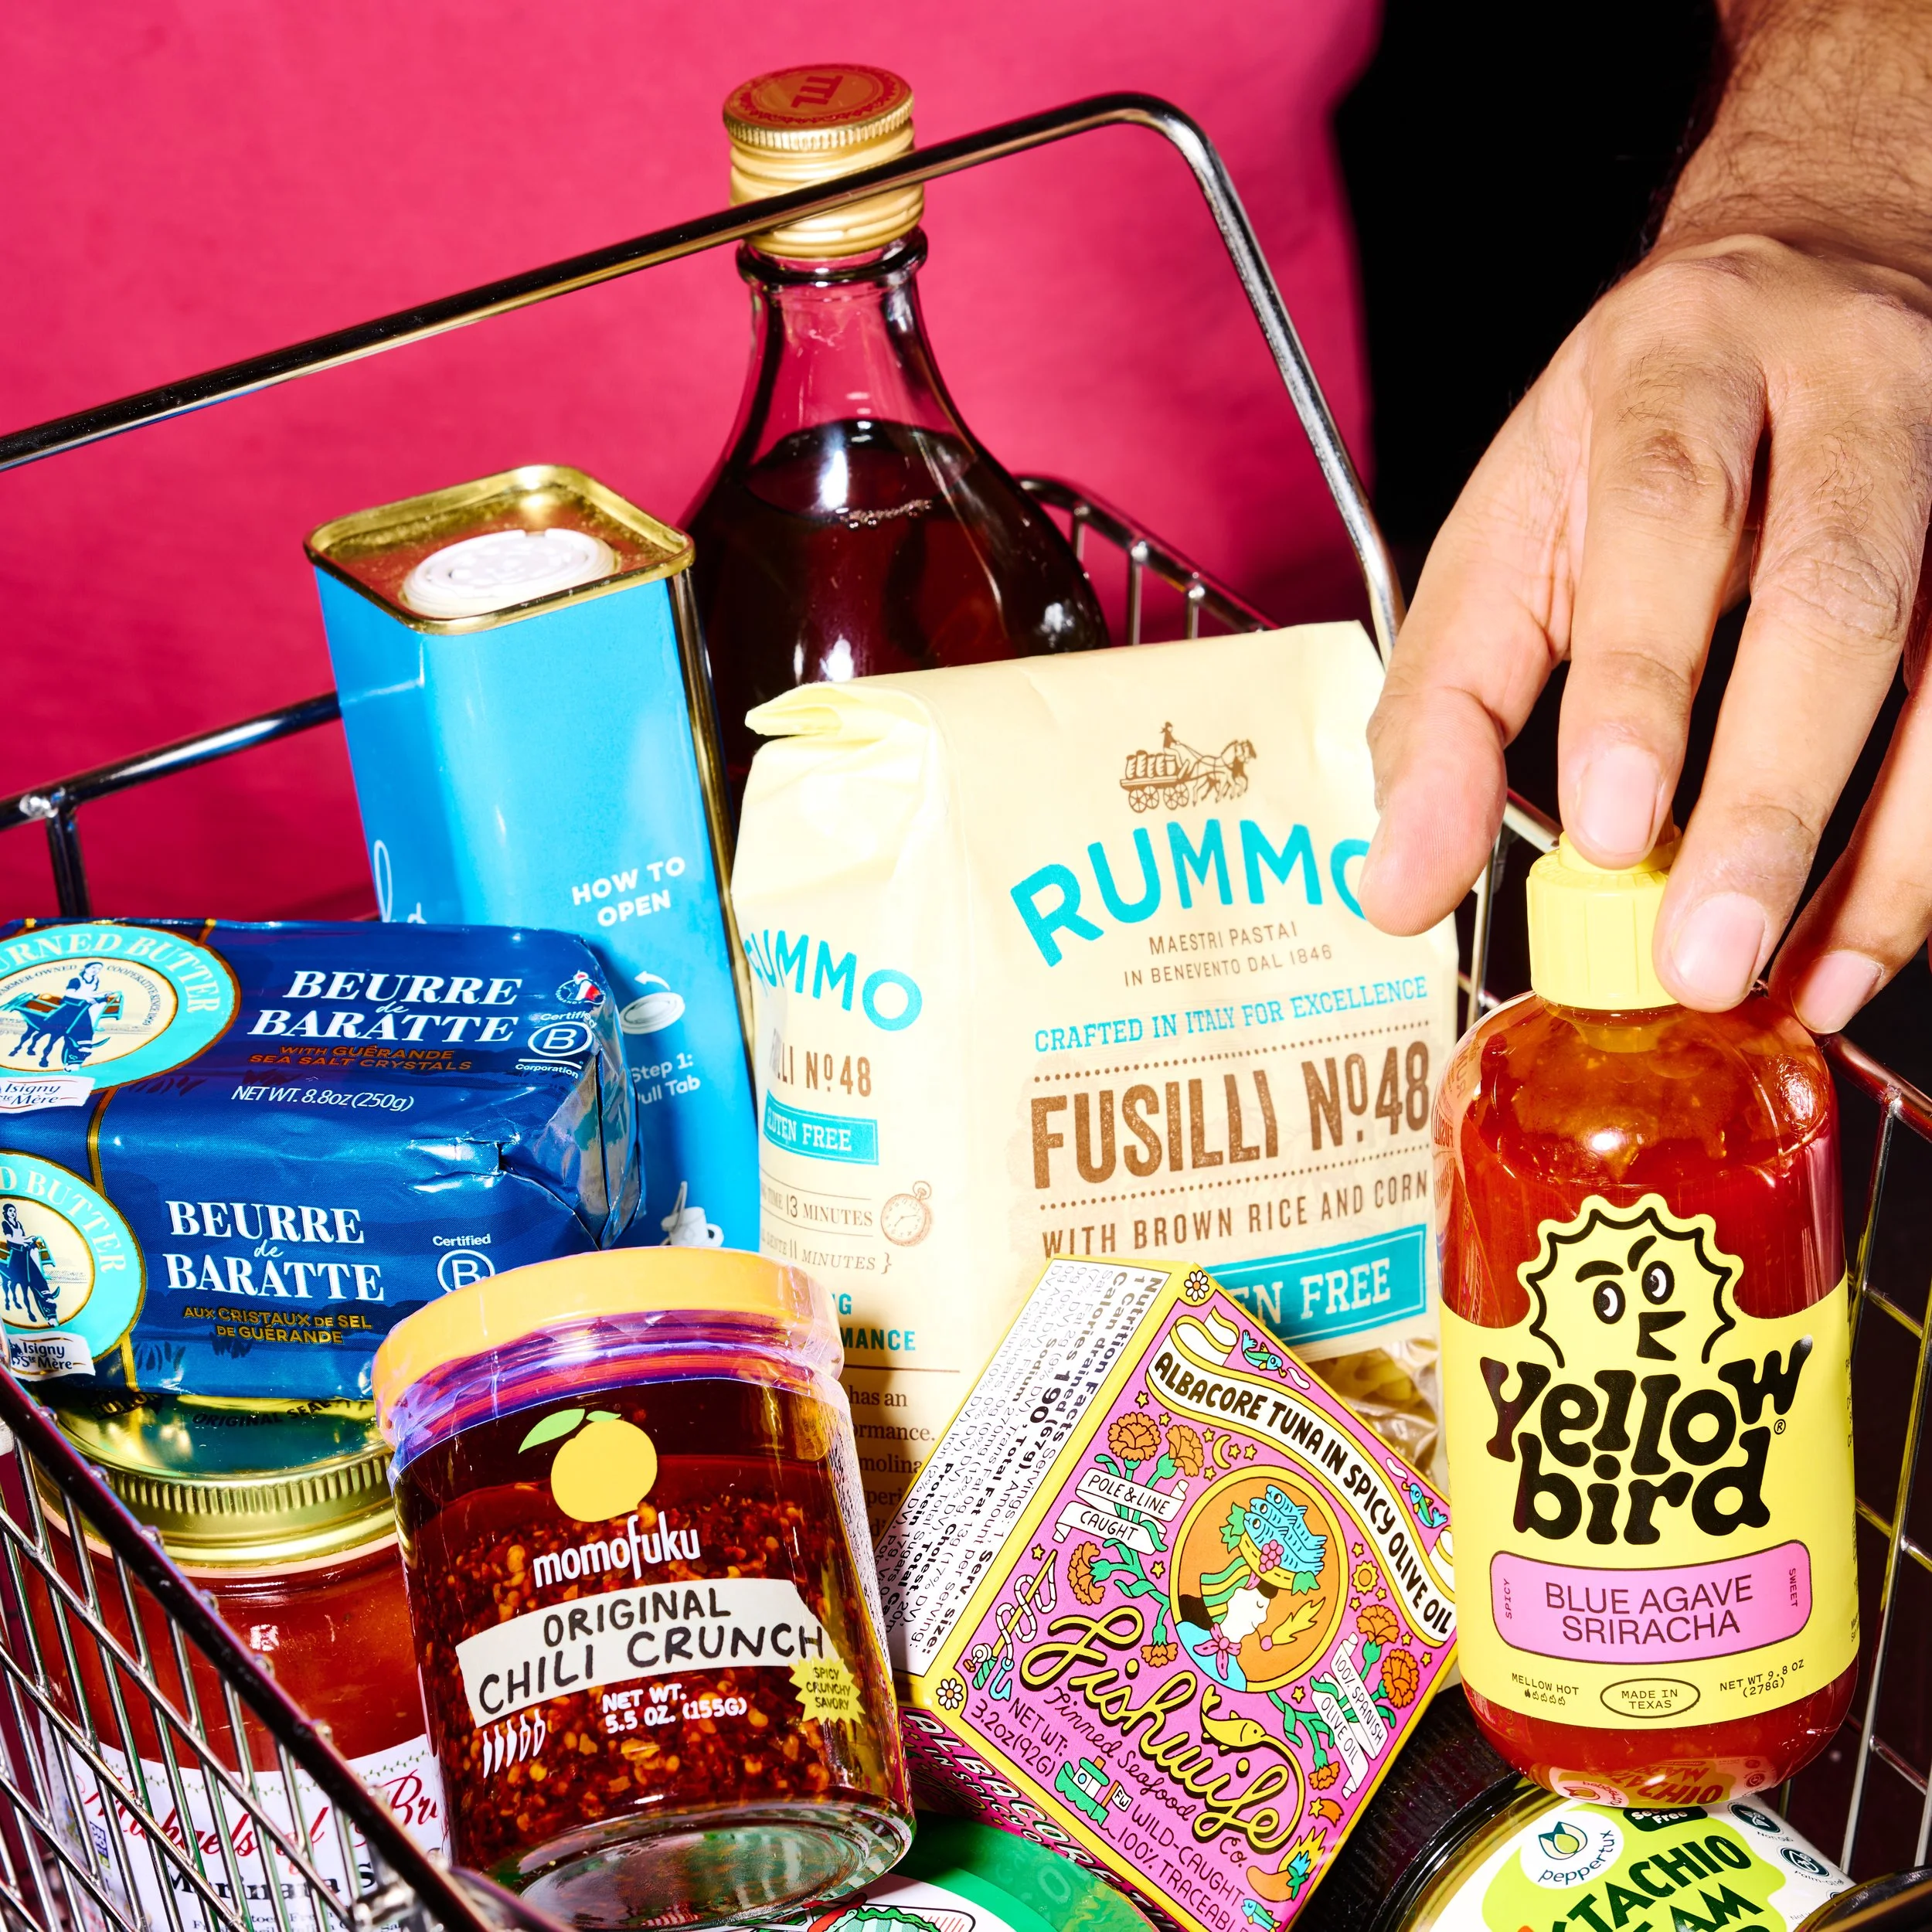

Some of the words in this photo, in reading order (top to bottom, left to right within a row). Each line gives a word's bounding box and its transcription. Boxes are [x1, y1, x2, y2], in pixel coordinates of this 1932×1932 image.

[570, 869, 639, 906] HOW
[647, 855, 686, 883] TO
[597, 889, 672, 927] OPEN
[1149, 930, 1225, 956] MAESTRI
[1230, 921, 1298, 946] PASTAI
[124, 936, 221, 1014] BUTTER
[1124, 970, 1143, 987] IN
[1150, 959, 1240, 984] BENEVENTO
[1247, 952, 1283, 972] DAL
[1291, 944, 1333, 966] 1846
[282, 971, 522, 1005] BEURRE
[376, 1001, 410, 1014] de
[247, 1009, 519, 1043] BARATTE
[540, 1011, 597, 1029] Certified
[1034, 1018, 1143, 1053] CRAFTED
[1153, 1012, 1178, 1037] IN
[1185, 1006, 1236, 1035] ITALY
[1243, 999, 1286, 1026] FOR
[1290, 976, 1428, 1018] EXCELLENCE
[249, 1055, 291, 1064] SEA
[298, 1056, 354, 1066] SALT
[359, 1059, 472, 1070] CRYSTALS
[280, 1046, 327, 1056] WITH
[332, 1045, 454, 1060] GUÉRANDE
[515, 1063, 579, 1079] Corporation
[631, 1060, 672, 1083] Step
[676, 1052, 693, 1070] 1:
[5, 1083, 61, 1095] Isigny
[231, 1086, 270, 1101] NET
[270, 1087, 301, 1103] WT.
[665, 1074, 701, 1097] Tab
[801, 1123, 852, 1151] FREE
[1030, 1070, 1279, 1189] FUSILLI
[25, 1171, 126, 1273] BUTTER
[165, 1200, 365, 1244] BEURRE
[787, 1194, 798, 1218] 13
[803, 1203, 873, 1227] MINUTES
[1043, 1223, 1117, 1260] WITH
[1134, 1208, 1233, 1250] BROWN
[1248, 1196, 1308, 1233] RICE
[1321, 1185, 1363, 1221] AND
[1375, 1171, 1428, 1209] CORN
[253, 1239, 284, 1258] de
[433, 1233, 491, 1247] Certified
[801, 1249, 876, 1270] MINUTES
[162, 1253, 385, 1301] BARATTE
[1300, 1257, 1391, 1320] FREE
[183, 1307, 216, 1319] AUX
[218, 1308, 311, 1327] CRISTAUX
[315, 1316, 334, 1327] DE
[337, 1315, 372, 1329] SEL
[998, 1298, 1040, 1361] Calcium
[1065, 1268, 1128, 1365] Calories
[1093, 1273, 1163, 1378] Nutrition
[1104, 1289, 1136, 1333] Can
[22, 1342, 65, 1359] Isigny
[216, 1325, 236, 1337] DE
[239, 1325, 345, 1345] GUÉRANDE
[38, 1358, 73, 1370] Mère
[1011, 1335, 1058, 1405] Sodium
[1054, 1335, 1107, 1415] drained
[849, 1386, 879, 1406] has
[884, 1392, 907, 1407] an
[1051, 1377, 1098, 1446] Facts
[1480, 1335, 1813, 1476] Yellow
[191, 1411, 284, 1428] ORIGINAL
[935, 1430, 959, 1461] Iron
[987, 1420, 1019, 1466] Trans
[991, 1431, 1027, 1483] Total
[907, 1459, 954, 1529] Protein
[970, 1466, 991, 1493] Fat
[1088, 1475, 1125, 1498] POLE
[1137, 1492, 1170, 1515] LINE
[1154, 1352, 1267, 1420] ALBACORE
[1266, 1401, 1324, 1456] TUNA
[1322, 1439, 1348, 1475] IN
[1343, 1464, 1396, 1535] SPICY
[1389, 1531, 1428, 1609] OLIVE
[1423, 1599, 1453, 1634] OIL
[1513, 1427, 1770, 1544] bird
[921, 1490, 948, 1528] Total
[970, 1484, 995, 1518] Fat
[972, 1478, 1019, 1548] Amount
[948, 1519, 972, 1549] 13g
[1080, 1511, 1138, 1540] CAUGHT
[533, 1511, 700, 1588] momofuku
[885, 1527, 925, 1585] Sugars
[897, 1537, 932, 1588] Total
[905, 1520, 957, 1600] Cholest.
[952, 1546, 977, 1578] per
[953, 1546, 993, 1604] Serv.
[1545, 1581, 1630, 1614] BLUE
[1638, 1574, 1753, 1615] AGAVE
[1788, 1568, 1798, 1607] SWEET
[543, 1588, 731, 1647] ORIGINAL
[1504, 1578, 1512, 1619] SPICY
[920, 1605, 957, 1657] size:
[1562, 1611, 1740, 1645] SRIRACHA
[479, 1645, 593, 1715] CHILI
[627, 1624, 824, 1668] CRUNCH
[812, 1666, 840, 1679] SPICY
[1512, 1672, 1553, 1692] MELLOW
[1556, 1685, 1580, 1696] HOT
[1719, 1679, 1744, 1692] NET
[1747, 1674, 1763, 1685] WT
[1767, 1665, 1789, 1680] 9.8
[1791, 1659, 1804, 1670] OZ
[1743, 1677, 1785, 1699] (278G)
[602, 1689, 644, 1713] NET
[648, 1683, 688, 1704] WT.
[806, 1682, 851, 1697] CRUNCHY
[815, 1696, 850, 1710] SAVORY
[1335, 1655, 1355, 1688] 100%
[1352, 1686, 1384, 1746] SPANISH
[1621, 1689, 1657, 1699] MADE
[1662, 1689, 1679, 1699] IN
[1629, 1699, 1672, 1709] TEXAS
[605, 1710, 638, 1735] 5.5
[644, 1705, 676, 1726] OZ.
[683, 1697, 747, 1721] (155G)
[1009, 1697, 1045, 1733] NET
[1041, 1724, 1067, 1757] WT:
[1321, 1697, 1348, 1736] OLIVE
[1343, 1738, 1359, 1765] OIL
[1043, 1687, 1123, 1758] Tinned
[1117, 1750, 1196, 1821] Seafood
[924, 1747, 957, 1768] IN
[953, 1770, 1026, 1827] SPICY
[1114, 1789, 1129, 1807] FW
[1651, 1811, 1688, 1824] Free
[1131, 1804, 1245, 1906] WILD-CAUGHT
[1538, 1830, 1615, 1885] peppertux
[1118, 1827, 1158, 1869] 100%
[1159, 1859, 1249, 1932] TRACEABL
[1551, 1835, 1751, 1932] TACHIO
